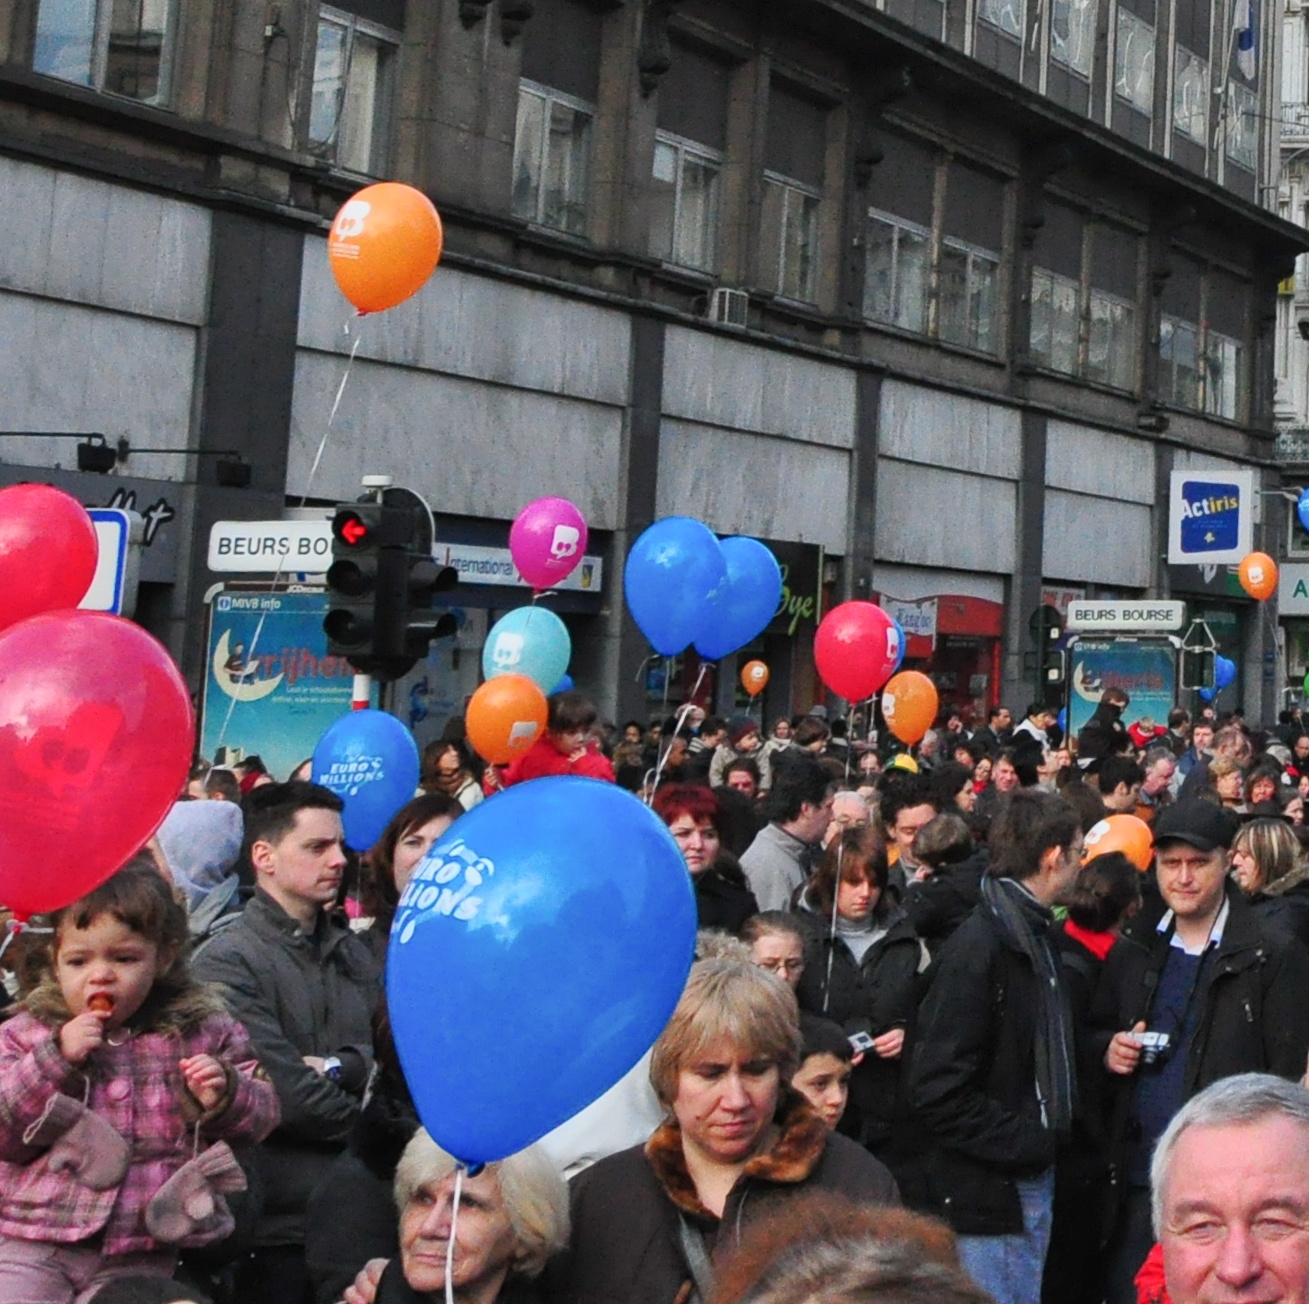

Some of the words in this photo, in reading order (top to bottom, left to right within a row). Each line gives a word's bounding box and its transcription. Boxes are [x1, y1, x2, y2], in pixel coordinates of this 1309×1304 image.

[1181, 496, 1239, 519] Actiris
[217, 537, 290, 556] BEURS
[231, 597, 259, 610] MIVB
[261, 597, 282, 611] info
[1074, 609, 1117, 622] BEURS
[1122, 609, 1174, 622] BOURSE
[329, 762, 369, 775] EURO
[318, 771, 386, 786] MILLIONS
